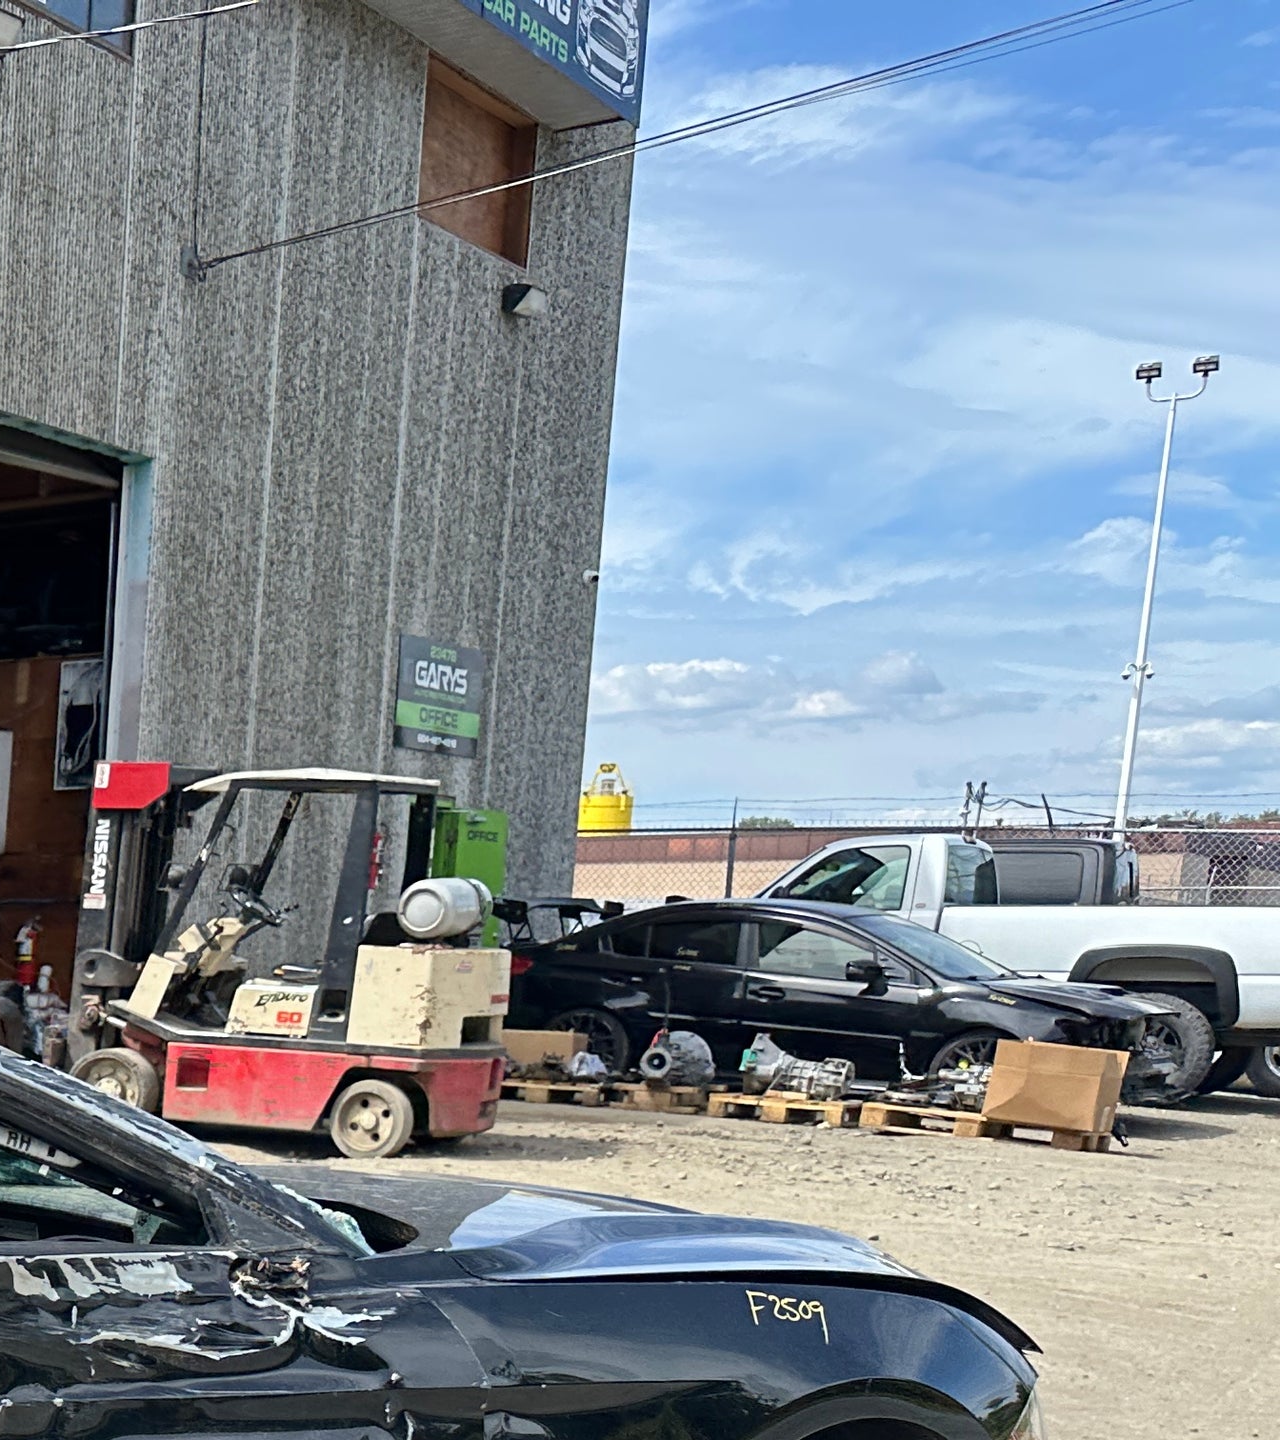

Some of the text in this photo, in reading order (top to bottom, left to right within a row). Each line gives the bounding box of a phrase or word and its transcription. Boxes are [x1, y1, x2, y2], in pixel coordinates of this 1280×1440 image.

[519, 11, 569, 63] PARTS
[415, 660, 468, 695] GARYS
[419, 706, 458, 729] OFFICE
[90, 818, 111, 894] NISSAN
[277, 1011, 303, 1024] 60
[6, 1130, 32, 1152] RH
[745, 1289, 829, 1345] F2509
